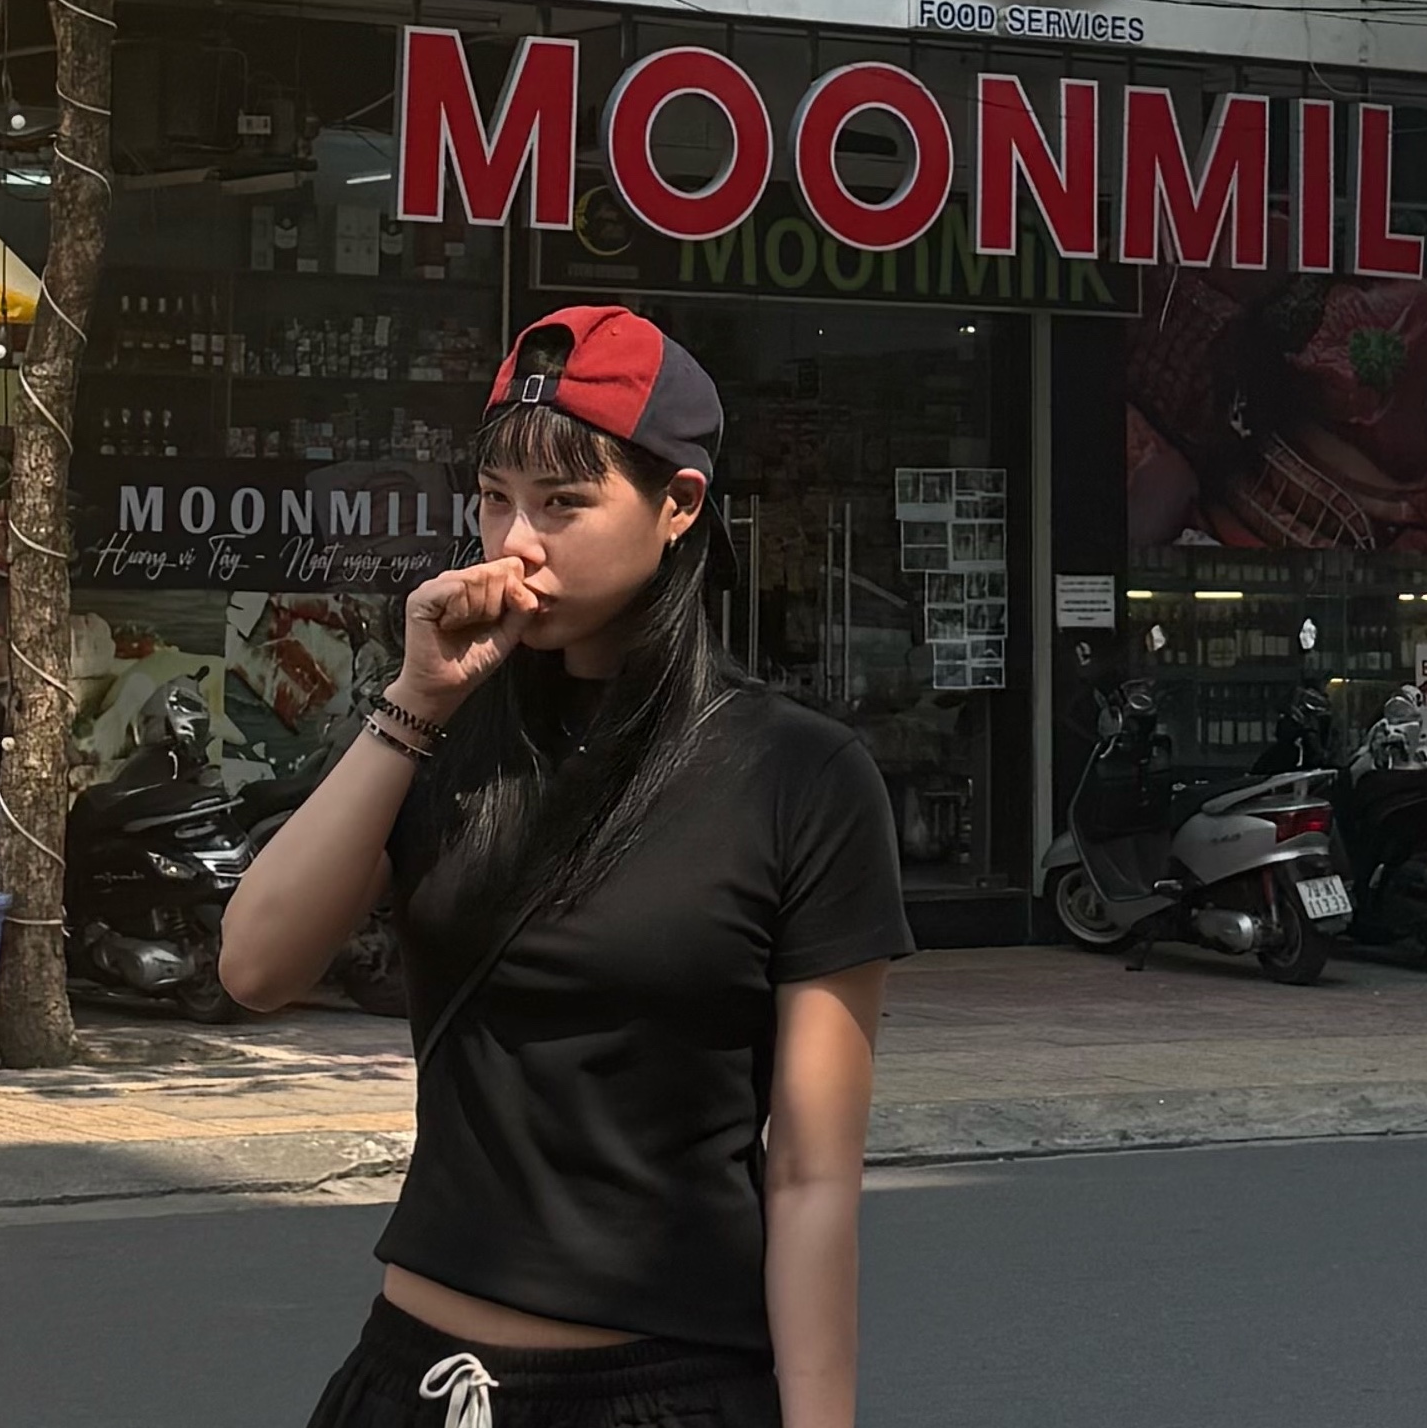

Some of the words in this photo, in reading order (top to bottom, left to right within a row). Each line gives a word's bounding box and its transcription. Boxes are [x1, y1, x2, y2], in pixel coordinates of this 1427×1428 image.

[920, 0, 995, 30] FOOD
[1007, 7, 1145, 42] SERVICES
[120, 485, 482, 537] MOONMILK
